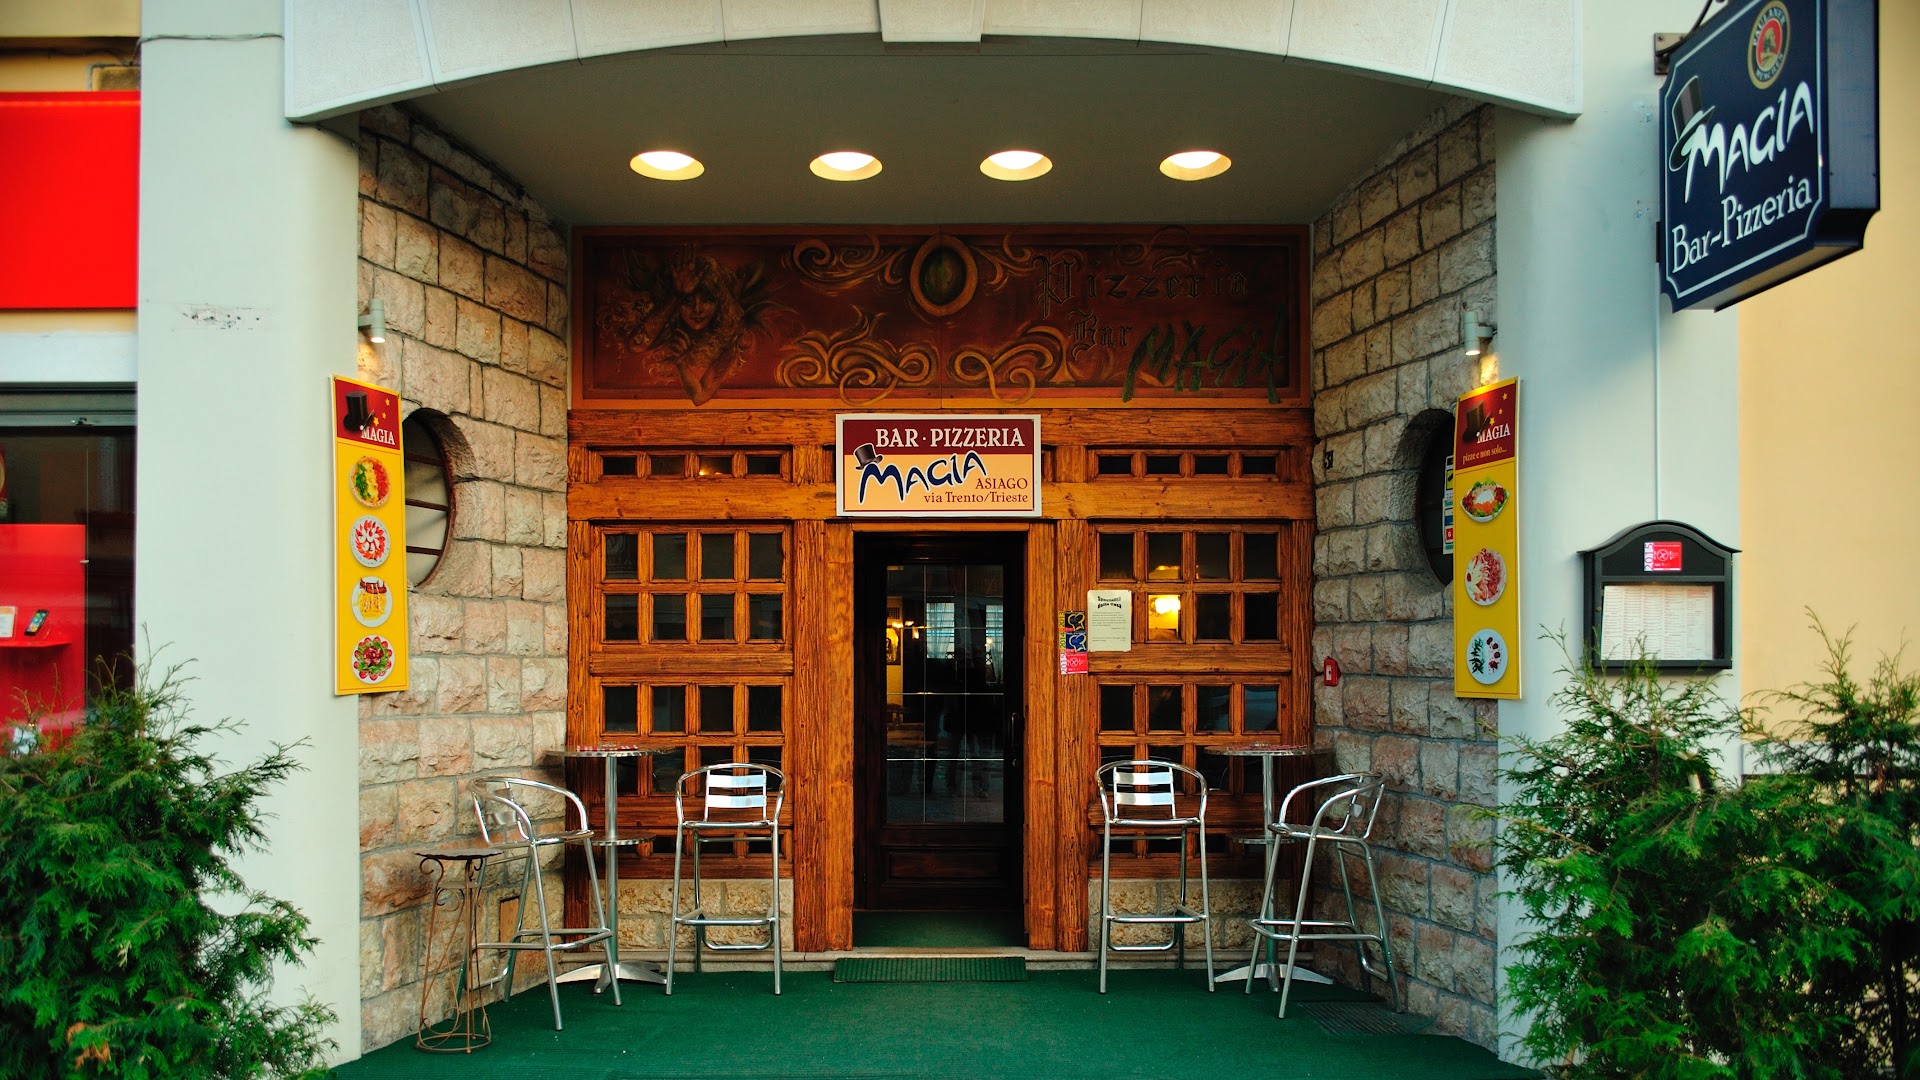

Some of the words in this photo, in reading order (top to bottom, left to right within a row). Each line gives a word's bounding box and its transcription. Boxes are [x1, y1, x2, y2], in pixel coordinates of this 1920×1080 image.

[1681, 81, 1814, 203] MAGIA
[1672, 175, 1813, 273] Bar-Pizzeria
[1033, 254, 1249, 320] Pizzeria
[1068, 309, 1133, 361] Bar
[1122, 303, 1284, 404] MAGIA
[361, 426, 395, 445] MAGIA
[876, 428, 919, 448] BAR
[930, 428, 1025, 448] PIZZERIA
[1477, 423, 1511, 444] MAGIA
[1462, 452, 1476, 465] pizze
[1480, 449, 1491, 458] non
[858, 450, 987, 504] MAGIA
[975, 478, 1028, 490] ASIAGO
[924, 493, 942, 503] via
[945, 491, 1028, 504] Trento/Trieste
[1644, 543, 1653, 570] 2015
